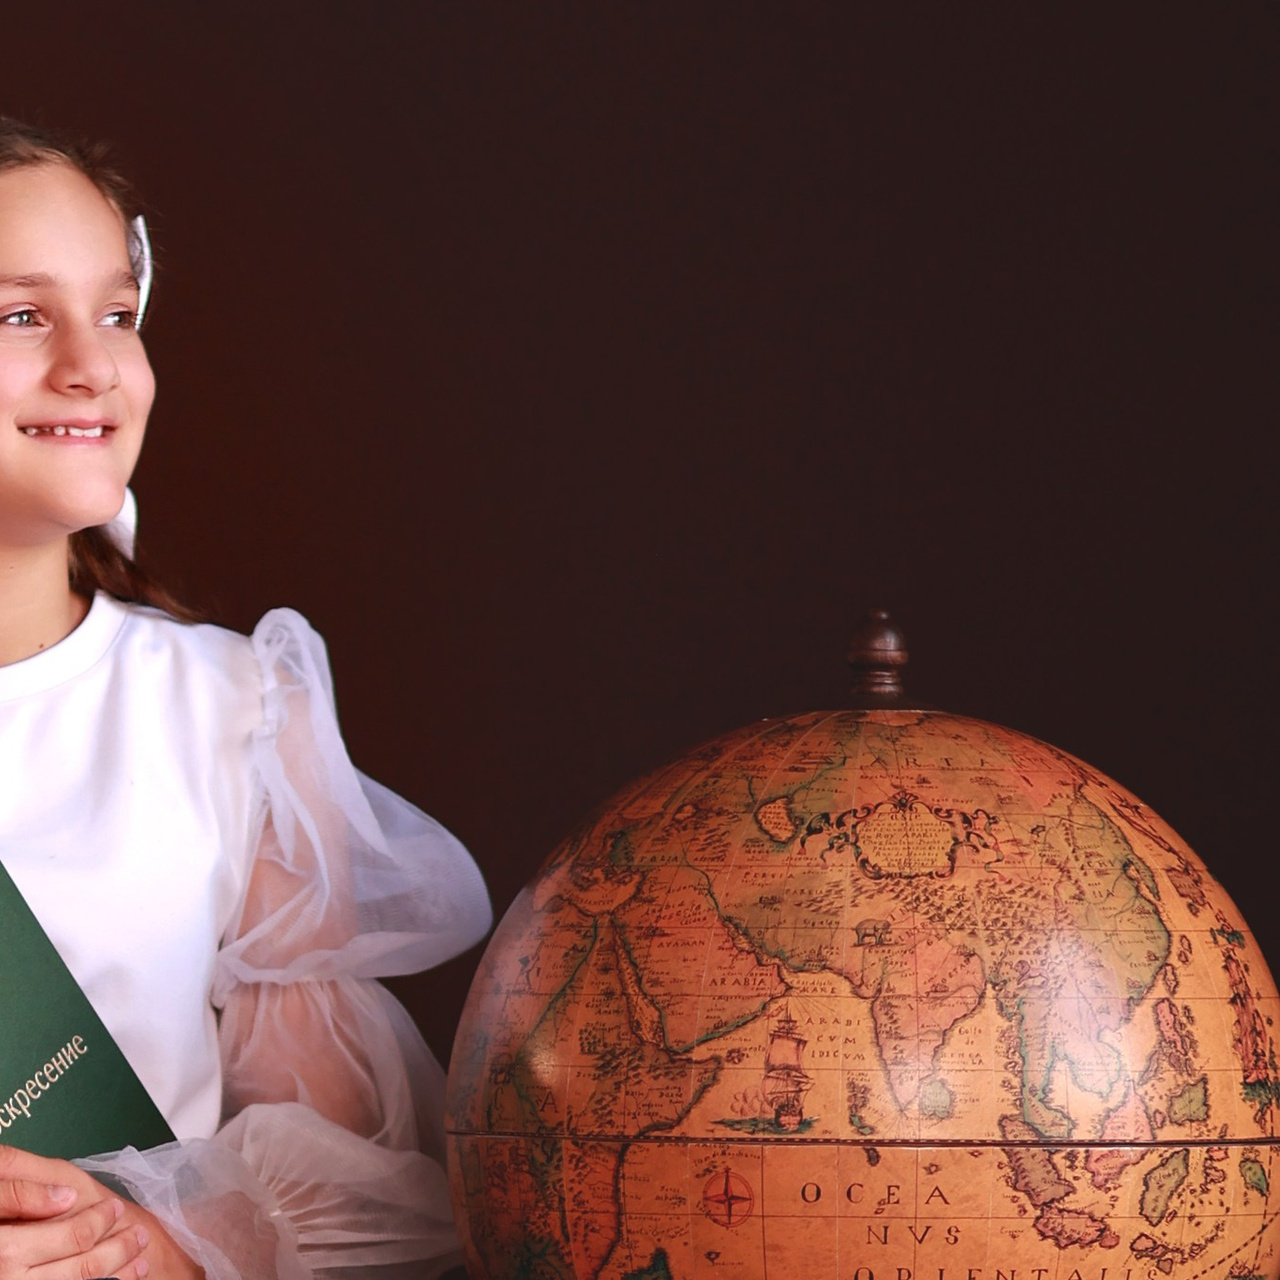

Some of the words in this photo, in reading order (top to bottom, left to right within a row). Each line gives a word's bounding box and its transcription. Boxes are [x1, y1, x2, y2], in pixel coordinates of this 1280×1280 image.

[709, 977, 767, 987] ARABIA
[800, 1183, 952, 1207] OCEA
[866, 1224, 962, 1246] NVS
